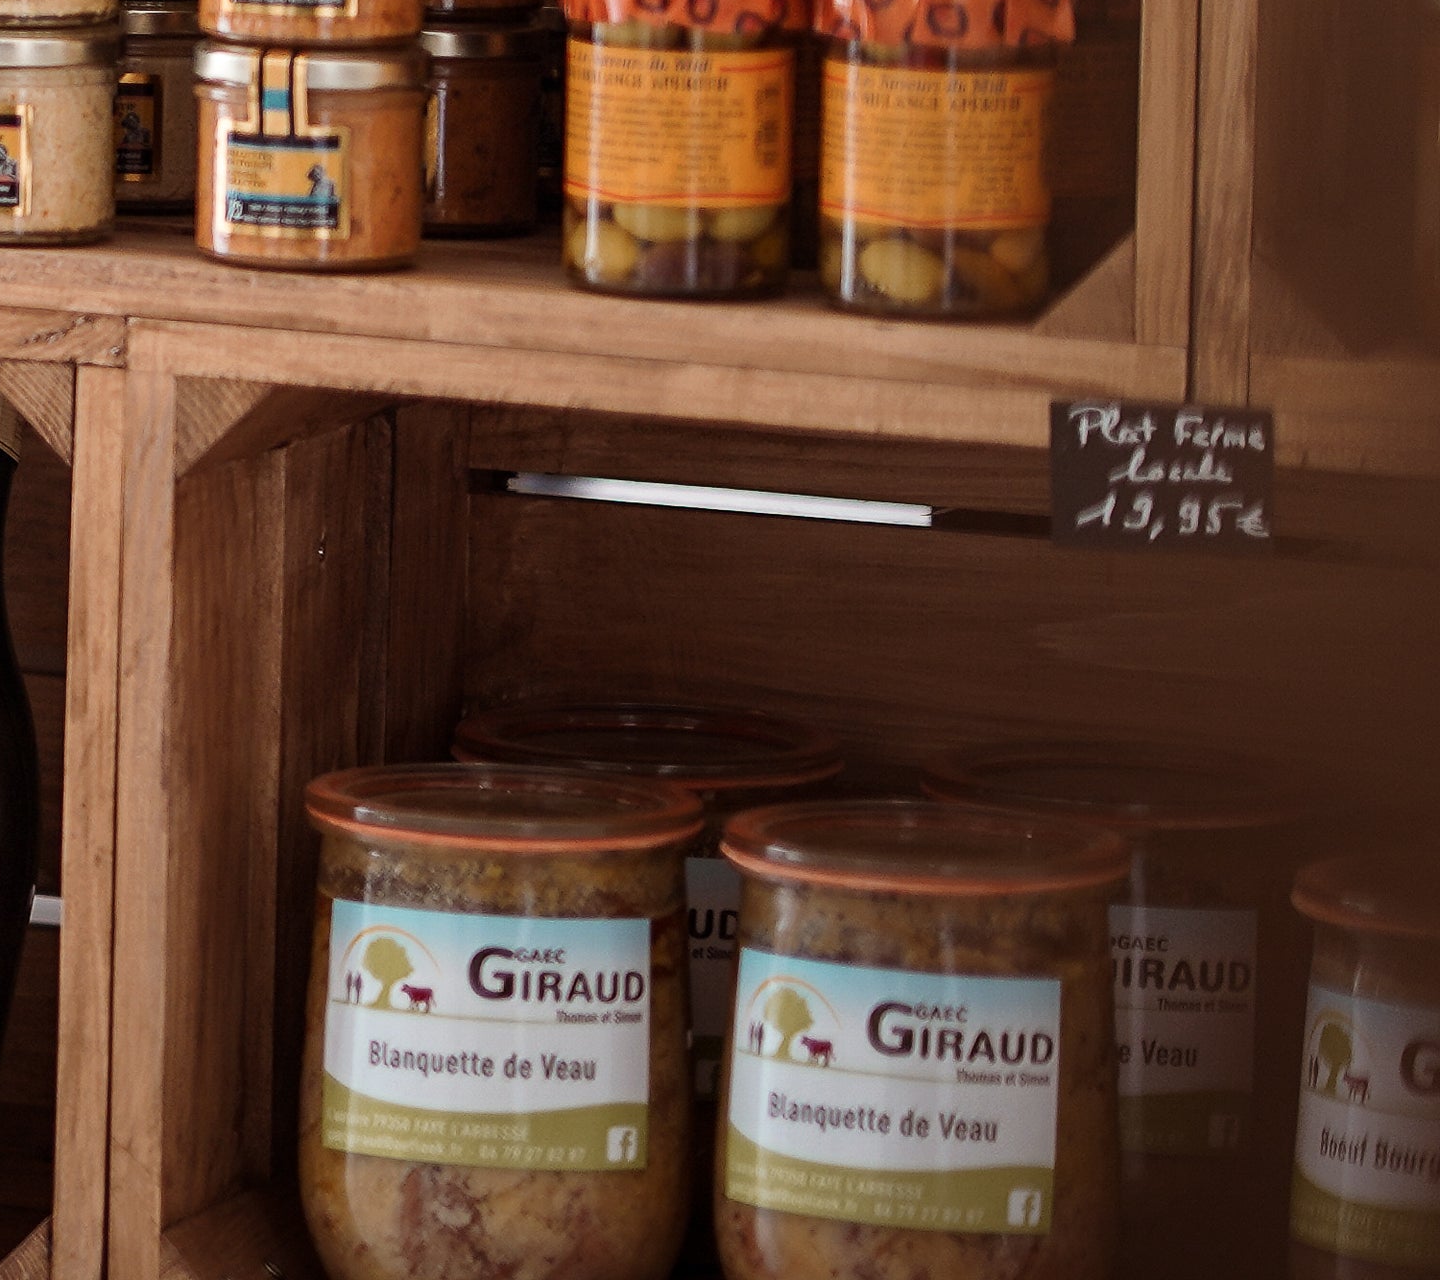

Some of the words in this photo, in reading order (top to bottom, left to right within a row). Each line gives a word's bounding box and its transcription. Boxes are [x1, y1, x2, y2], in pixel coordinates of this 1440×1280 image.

[1068, 402, 1157, 448] Plat
[1076, 491, 1271, 542] 19,95€
[466, 945, 645, 1004] GIRAUD
[514, 947, 567, 965] GAEC
[866, 1000, 1054, 1066] GIRAUD
[915, 1001, 969, 1023] GAEC
[368, 1040, 495, 1079] Blanquette
[502, 1052, 532, 1080] de
[540, 1053, 597, 1082] Veau
[1142, 1039, 1198, 1068] Veau
[766, 1090, 891, 1134] Blanquette
[898, 1107, 930, 1137] de
[938, 1112, 999, 1144] Veau
